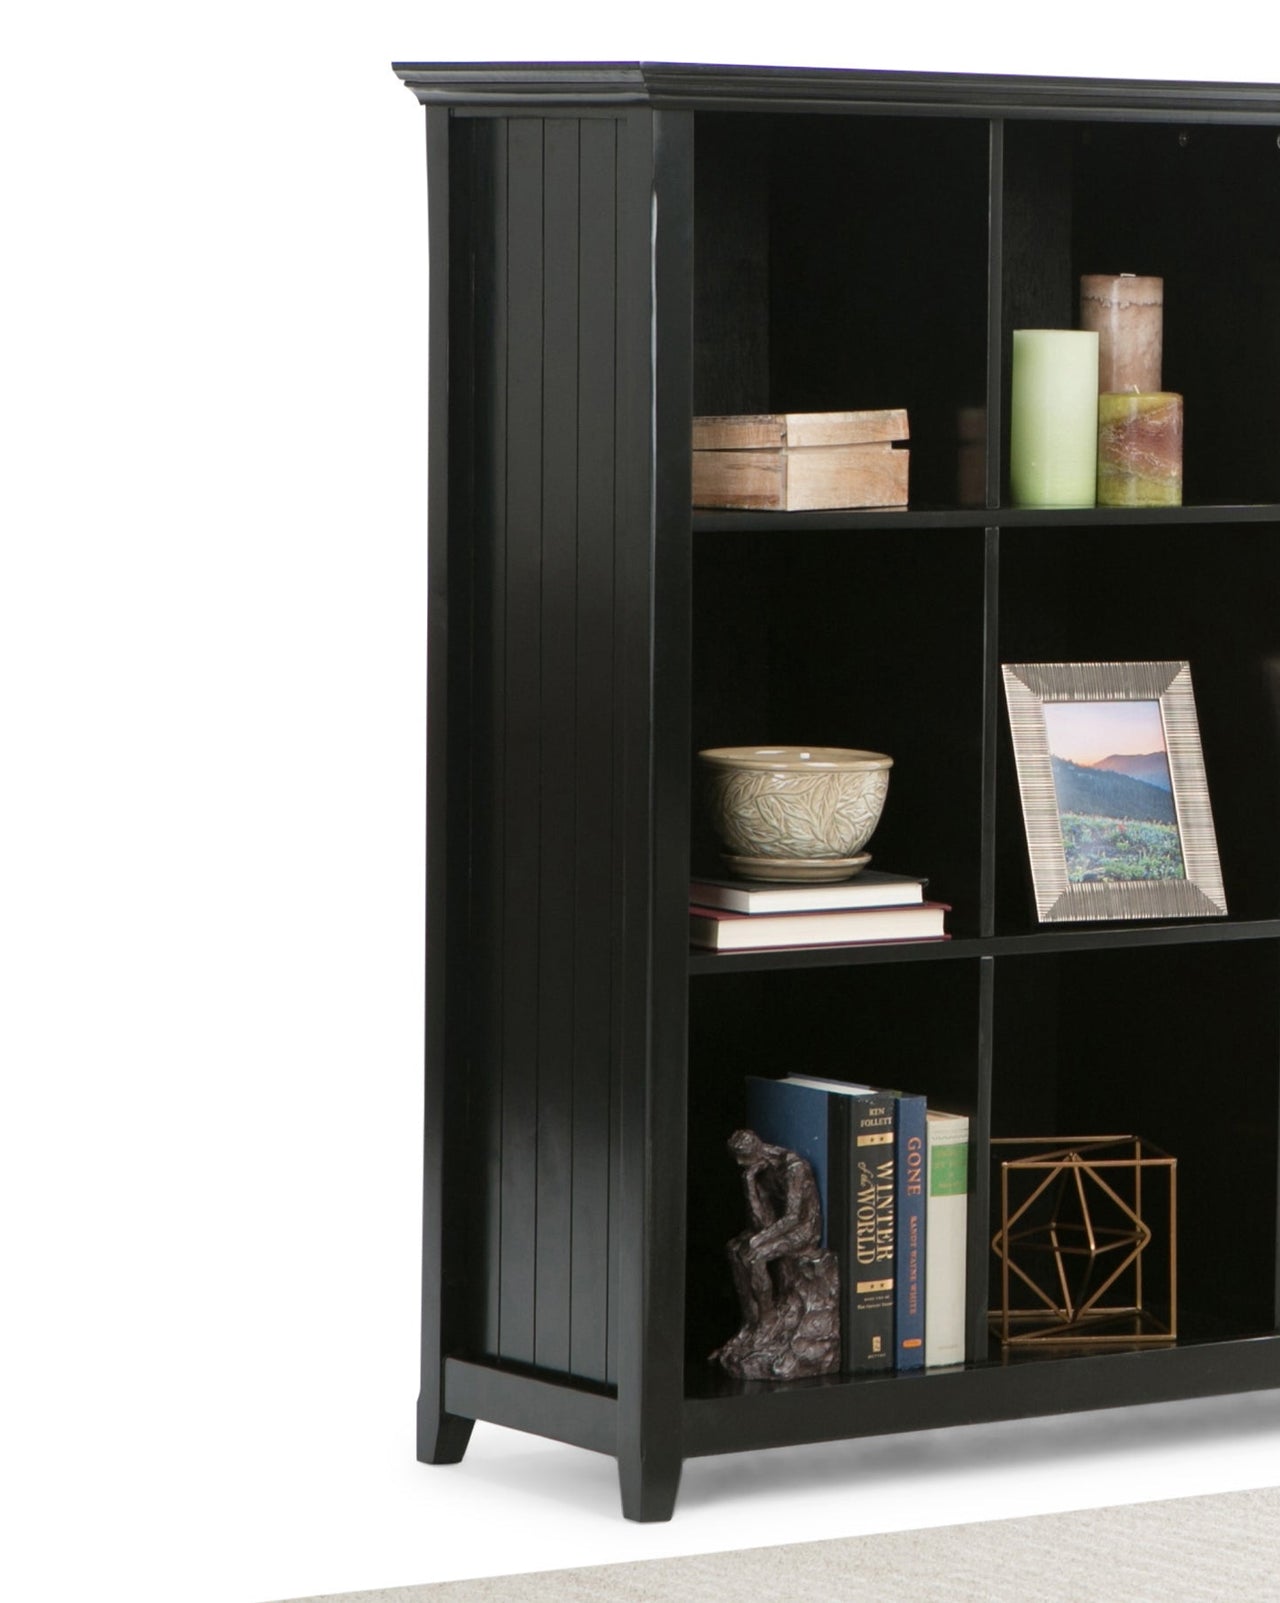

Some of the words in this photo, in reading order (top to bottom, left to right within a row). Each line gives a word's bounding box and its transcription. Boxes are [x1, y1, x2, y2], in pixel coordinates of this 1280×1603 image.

[860, 1117, 892, 1128] FOLLETT
[907, 1137, 922, 1196] GONE
[857, 1187, 876, 1265] WORLD
[876, 1161, 894, 1262] WINTER
[909, 1216, 918, 1247] RANDY
[909, 1249, 918, 1281] WAYNE
[909, 1283, 917, 1315] WHITE
